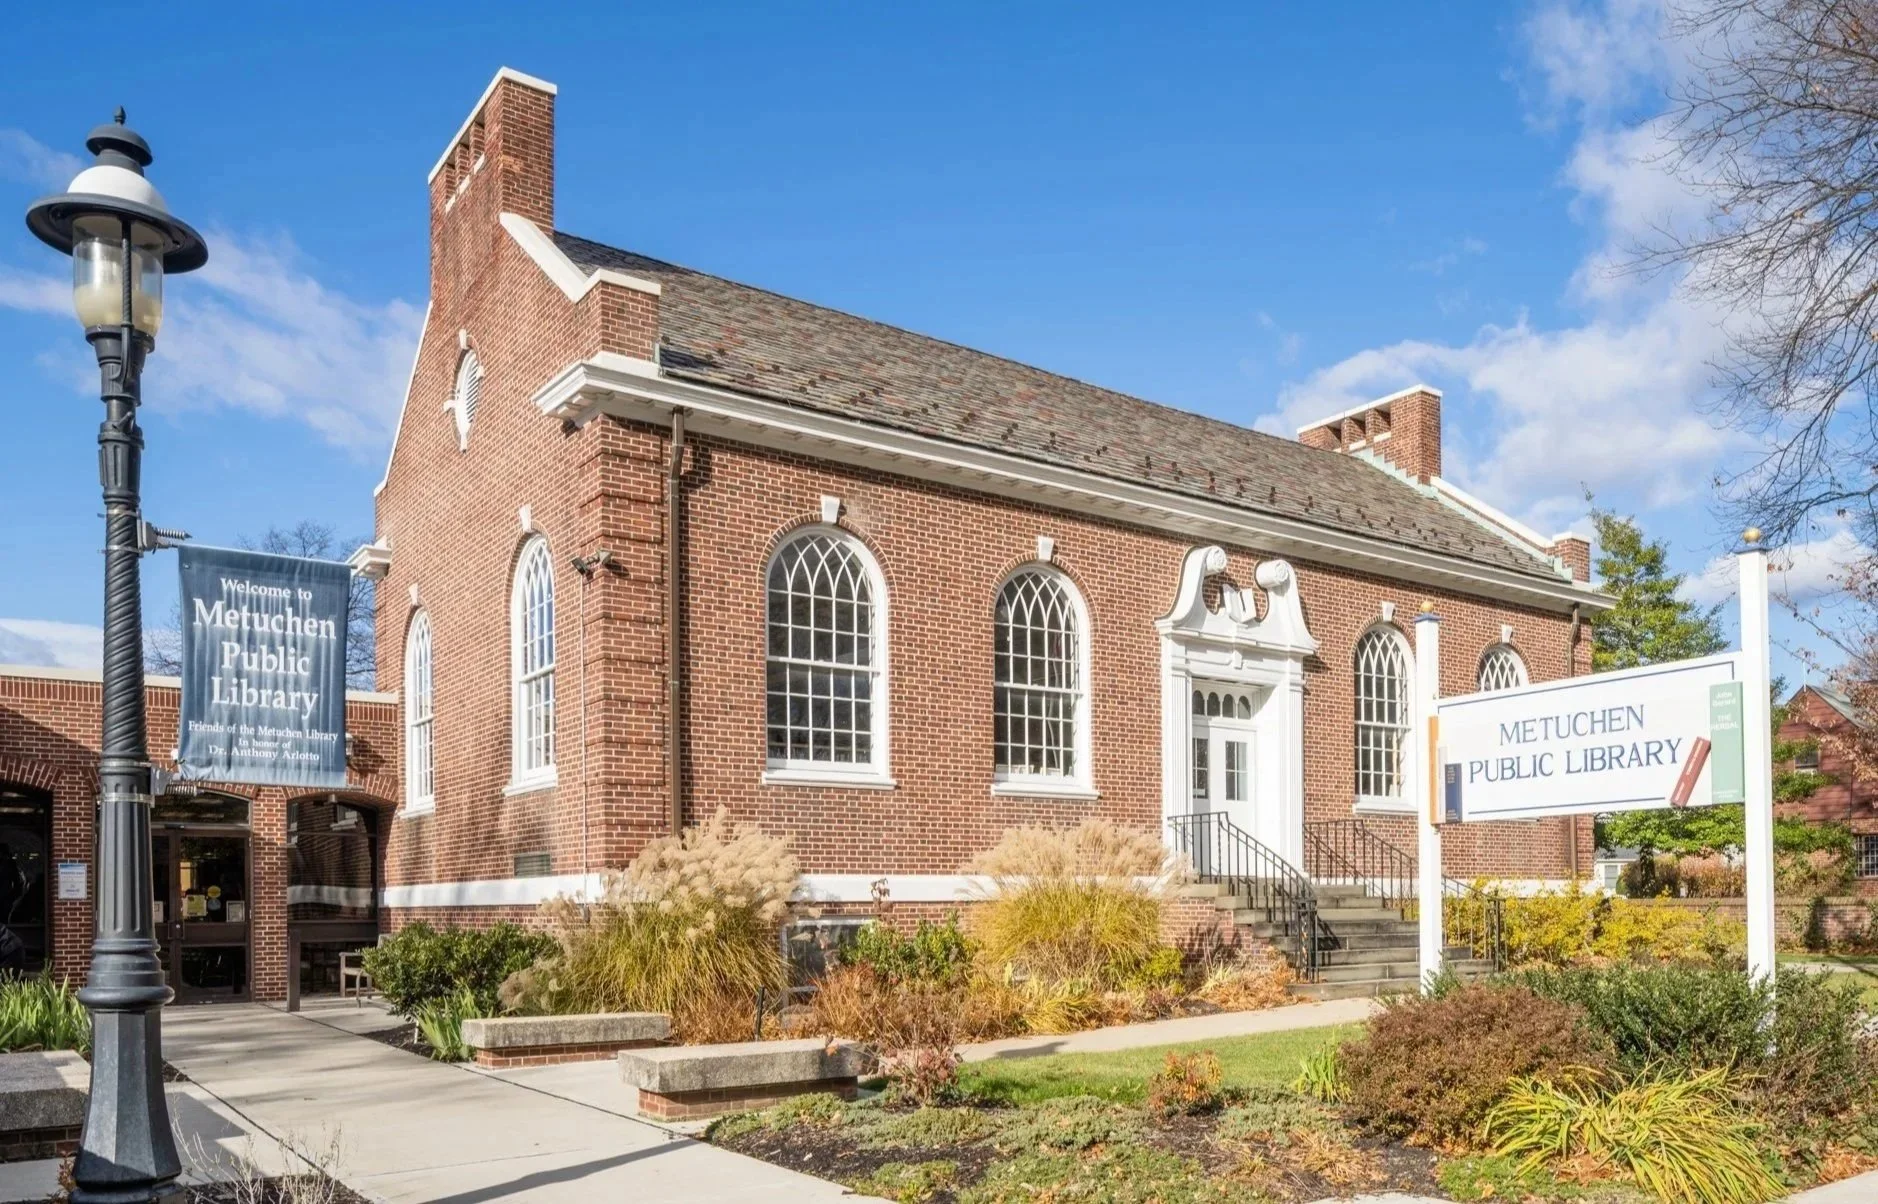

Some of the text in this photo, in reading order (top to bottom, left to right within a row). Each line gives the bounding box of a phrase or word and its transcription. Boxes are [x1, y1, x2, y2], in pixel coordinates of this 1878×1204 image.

[220, 577, 313, 601] Welcome to
[193, 598, 336, 640] Metuchen
[221, 641, 311, 676] Public
[211, 677, 319, 720] Library
[188, 720, 339, 743] Friends of the Metuchen Library
[1499, 704, 1645, 746] METUCHEN
[208, 744, 320, 761] Dr. Anthony Arlotto
[238, 738, 292, 749] In honor of
[1469, 753, 1554, 784] PUBLIC
[1565, 737, 1683, 775] LIBRARY
